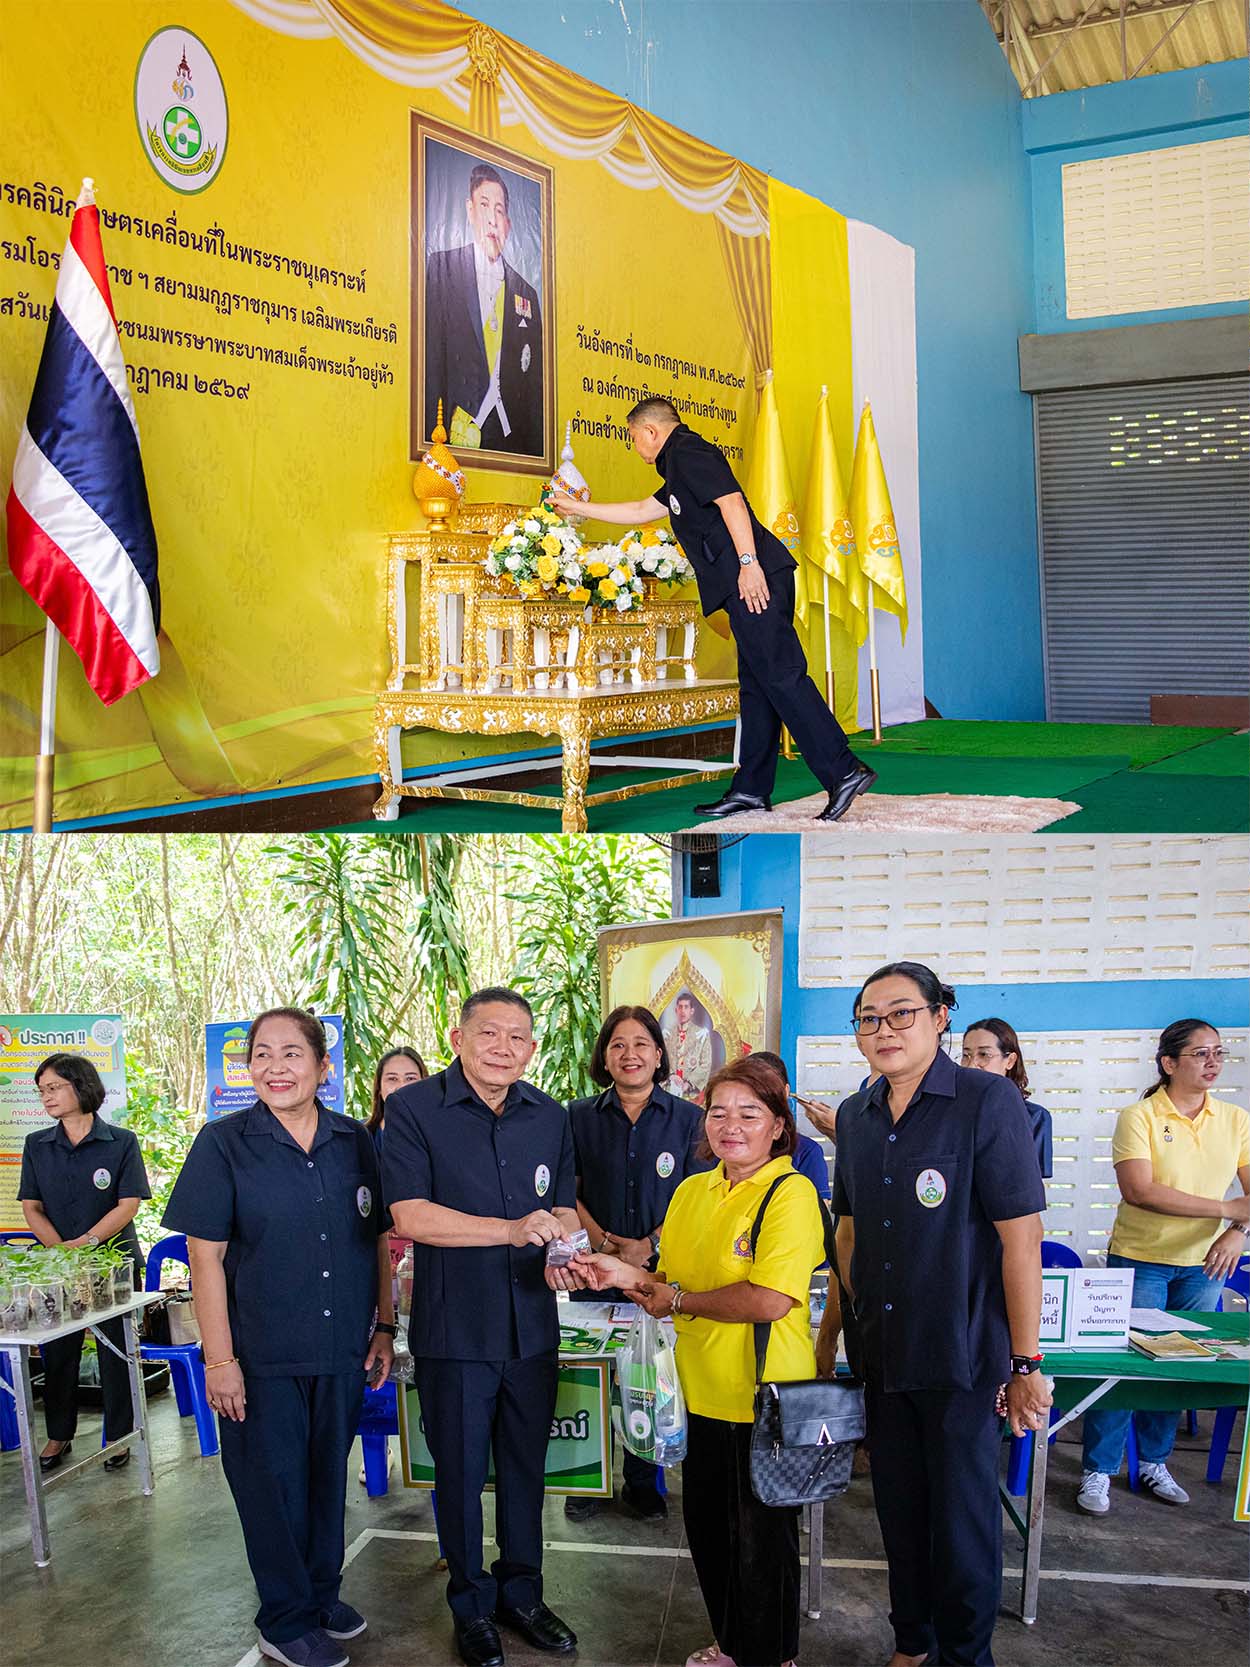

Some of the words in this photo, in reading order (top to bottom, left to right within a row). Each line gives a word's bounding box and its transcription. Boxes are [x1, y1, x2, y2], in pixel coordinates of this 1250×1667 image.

[154, 275, 297, 324] สยามมกุฎราชกุมาร
[301, 305, 398, 345] เฉลิมพระเกียรติ
[576, 324, 633, 361] วันอังคารที่
[635, 347, 651, 366] ๒๑
[653, 353, 697, 380] กรกฎาคม
[698, 365, 746, 389] พ.ศ.๒๕๖๙
[125, 364, 188, 394] กฎาคม
[193, 373, 250, 400] ๒๕๖๙
[582, 376, 594, 393] ณ
[571, 410, 635, 450] ตำบลช้างทู
[20, 1028, 75, 1045] ประกาศ
